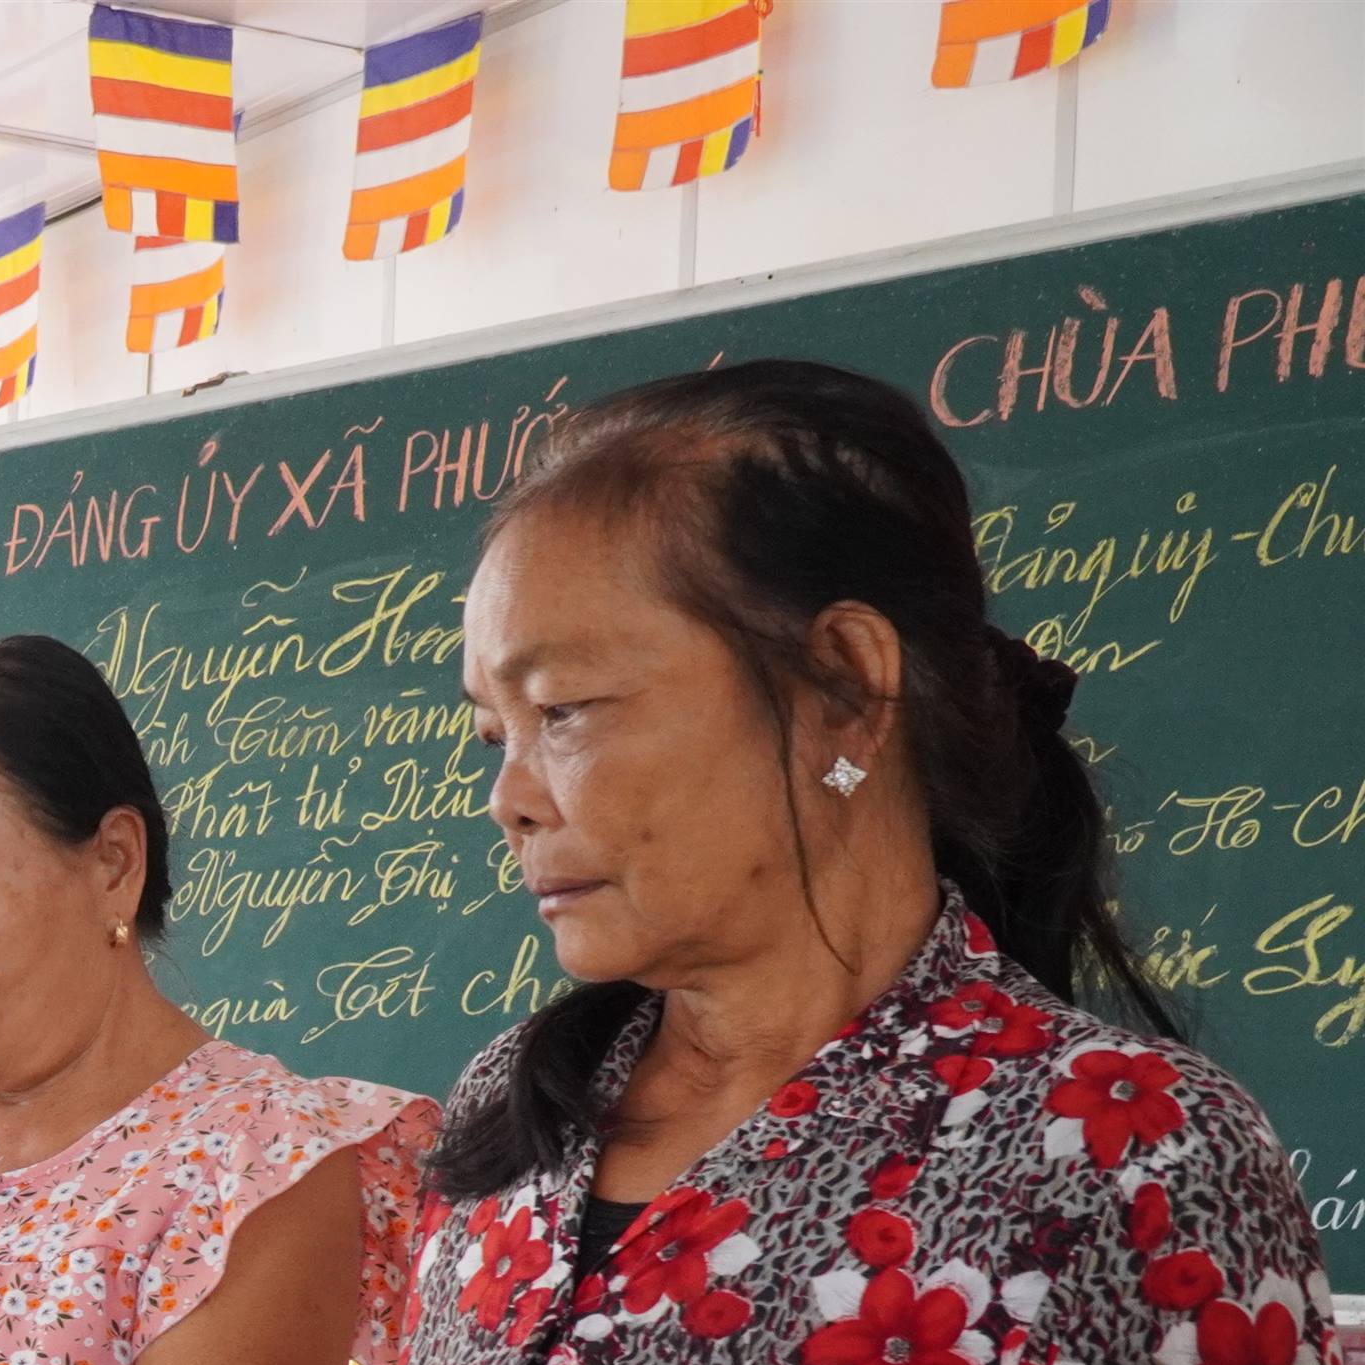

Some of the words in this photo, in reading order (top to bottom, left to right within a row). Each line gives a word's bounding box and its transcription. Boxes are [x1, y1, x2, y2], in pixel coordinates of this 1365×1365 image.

[3, 469, 162, 576] ĐẢNG
[268, 414, 384, 537] XÃ
[930, 285, 1178, 428] CHÙA
[169, 831, 367, 957] Nguyễn
